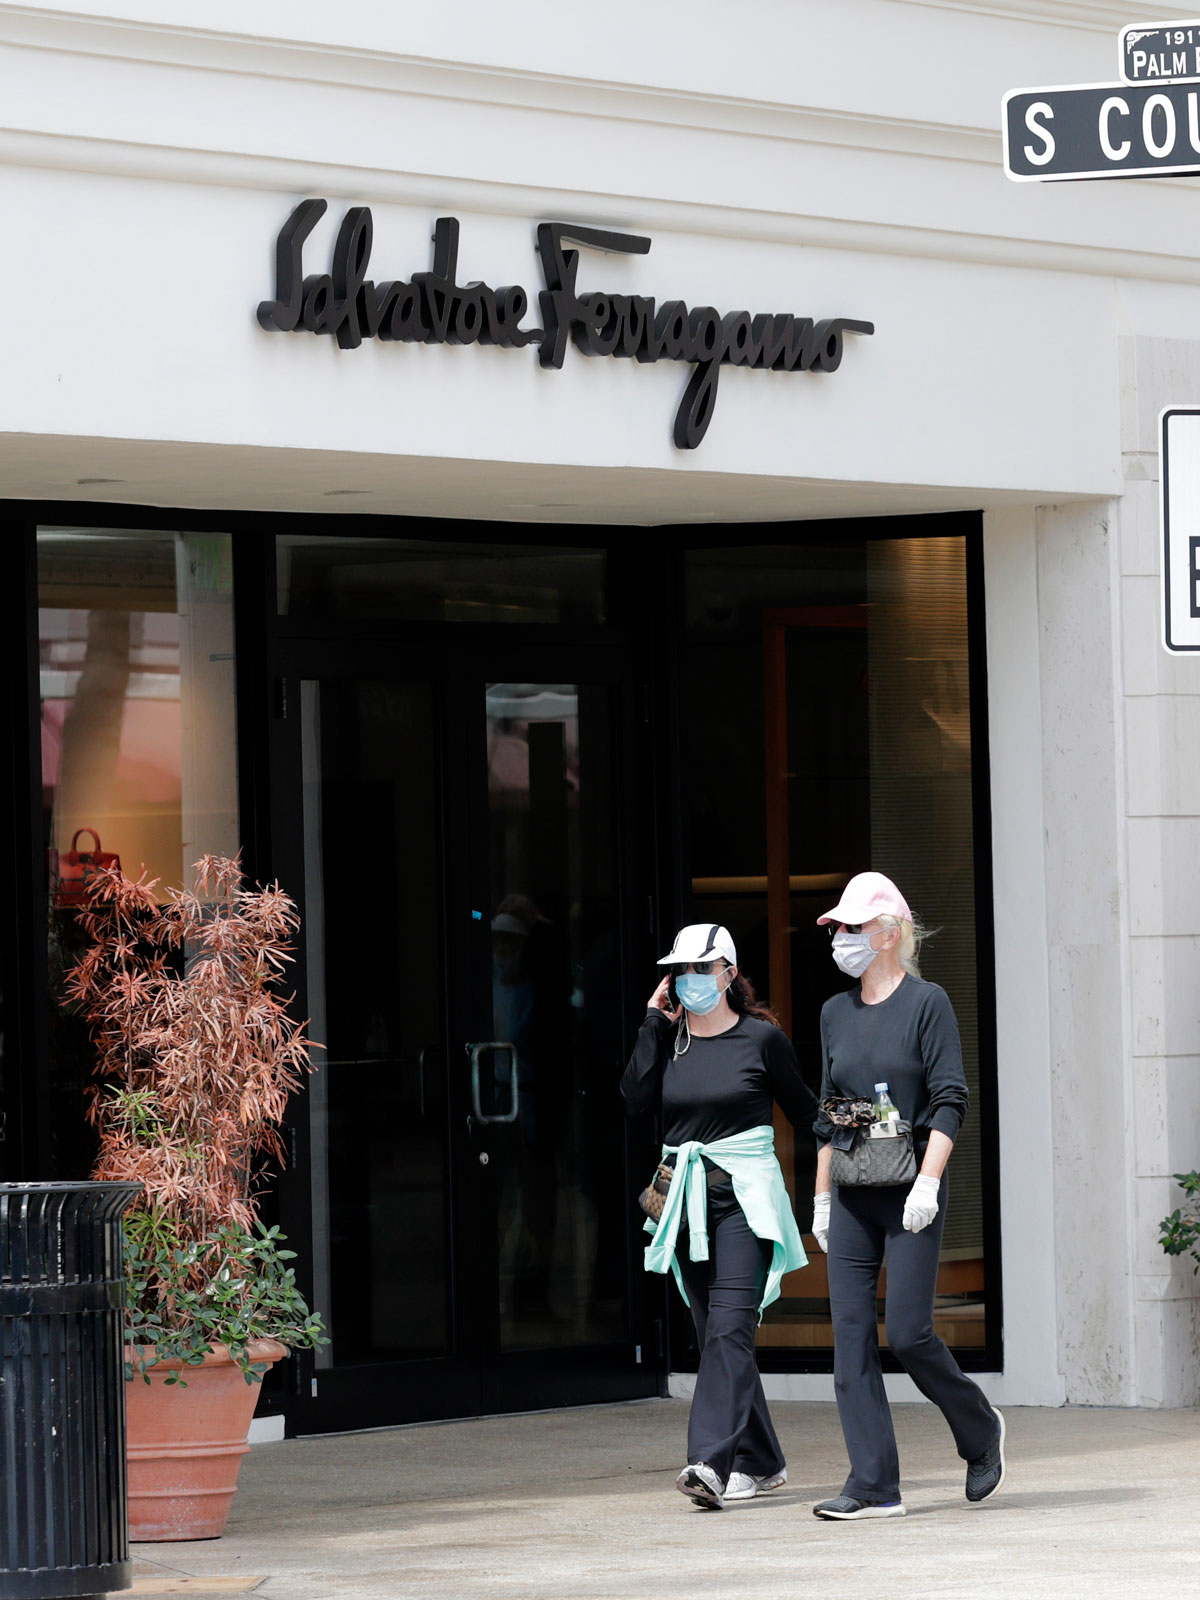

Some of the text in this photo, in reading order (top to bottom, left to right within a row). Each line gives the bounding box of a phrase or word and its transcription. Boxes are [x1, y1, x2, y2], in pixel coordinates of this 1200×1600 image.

[1132, 50, 1187, 78] PALM
[1022, 101, 1056, 167] S
[256, 198, 875, 450] Salvatore Ferragamo
